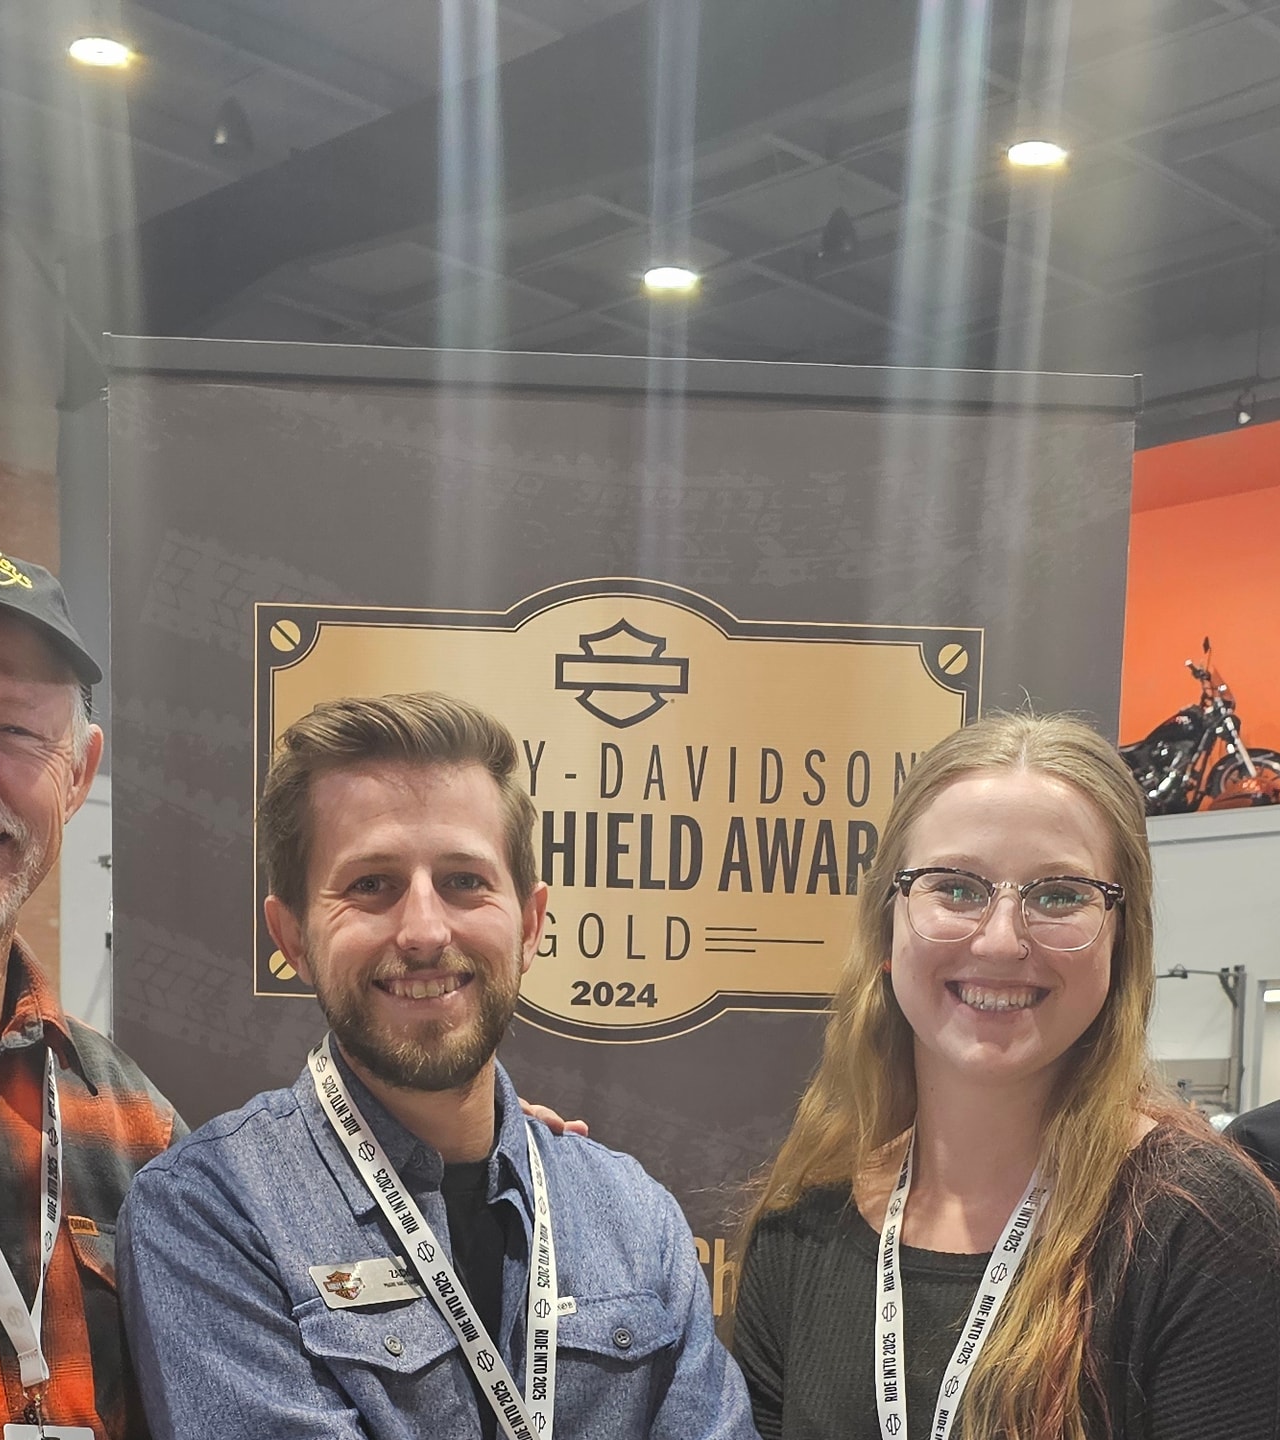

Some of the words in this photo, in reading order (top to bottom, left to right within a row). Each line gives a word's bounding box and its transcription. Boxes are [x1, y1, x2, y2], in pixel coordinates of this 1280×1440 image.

[523, 739, 917, 808] Y-DAVIDSON
[541, 811, 703, 892] HIELD
[719, 817, 879, 896] AWAR
[536, 911, 691, 961] GOLD
[570, 981, 658, 1008] 2024
[330, 1094, 347, 1116] INTO
[340, 1112, 362, 1136] RIDE
[373, 1167, 395, 1191] 2025
[385, 1189, 406, 1216] INTO
[398, 1208, 420, 1235] RIDE
[1014, 1206, 1035, 1229] INTO
[539, 1223, 549, 1244] RIDE
[885, 1225, 896, 1248] 2025
[1003, 1228, 1024, 1254] 2025
[538, 1245, 550, 1265] INTO
[883, 1247, 894, 1271] INTO
[431, 1270, 455, 1298] 2025
[537, 1265, 550, 1289] 2025
[883, 1270, 896, 1293] RIDE
[446, 1295, 467, 1323] INTO
[976, 1294, 996, 1320] RIDE
[458, 1315, 480, 1343] RIDE
[534, 1329, 549, 1351] RIDE
[967, 1316, 987, 1341] INTO
[882, 1332, 896, 1357] 2025
[956, 1340, 976, 1366] 2025
[533, 1351, 549, 1375] INTO
[883, 1356, 897, 1380] INTO
[490, 1380, 513, 1407] 2025
[532, 1375, 547, 1401] 2025
[884, 1380, 898, 1403] RIDE
[504, 1403, 525, 1432] INTO
[935, 1408, 950, 1432] RIDE
